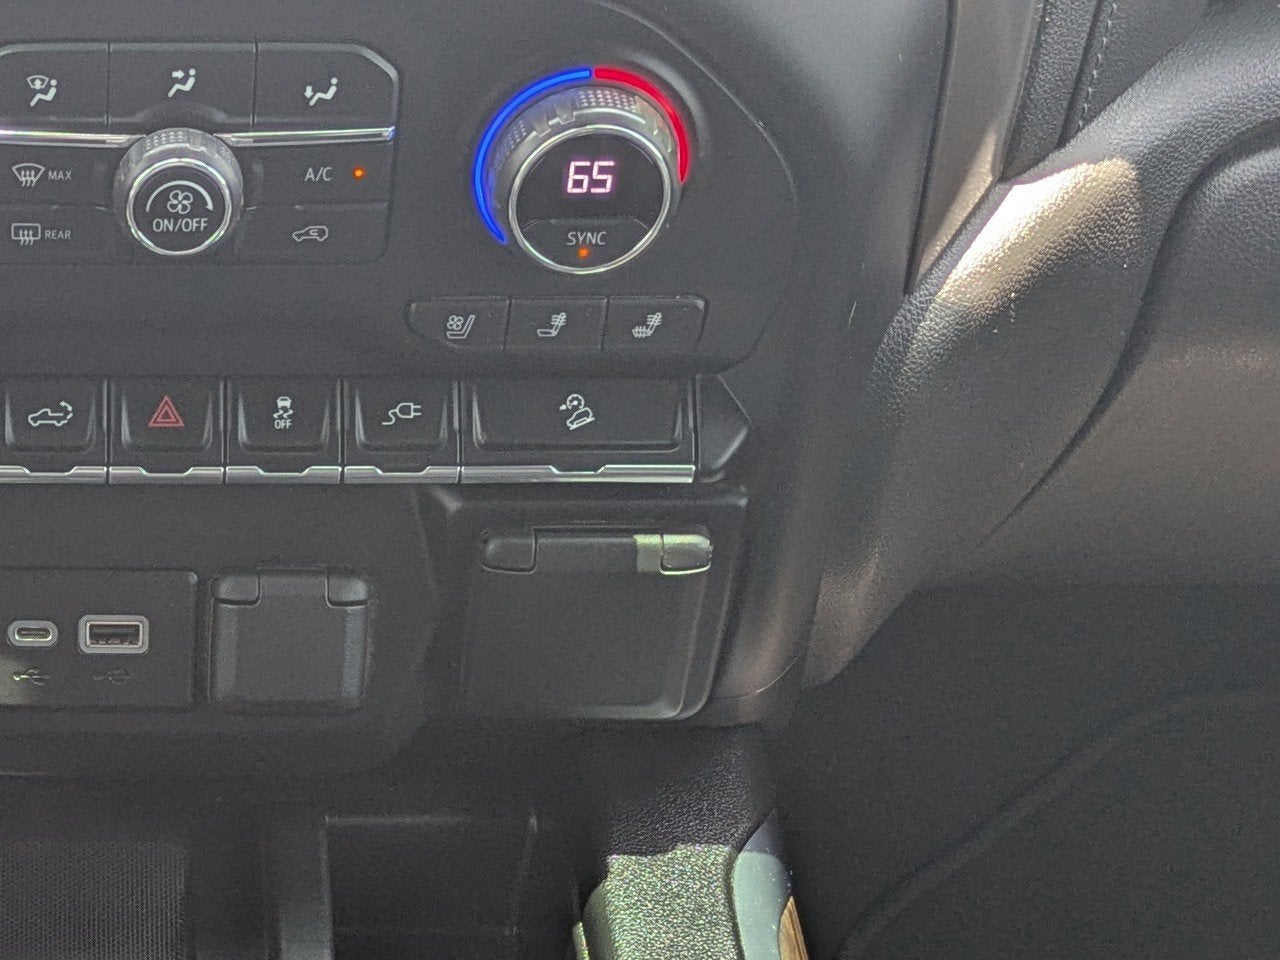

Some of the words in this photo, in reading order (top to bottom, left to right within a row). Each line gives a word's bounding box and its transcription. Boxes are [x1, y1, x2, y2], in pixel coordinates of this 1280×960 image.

[48, 170, 72, 181] MAX
[304, 167, 332, 182] A/C
[566, 161, 615, 194] 65
[152, 217, 209, 233] ON/OFF
[44, 229, 72, 241] REAR
[566, 231, 607, 246] SYNC
[273, 419, 292, 430] OFF
